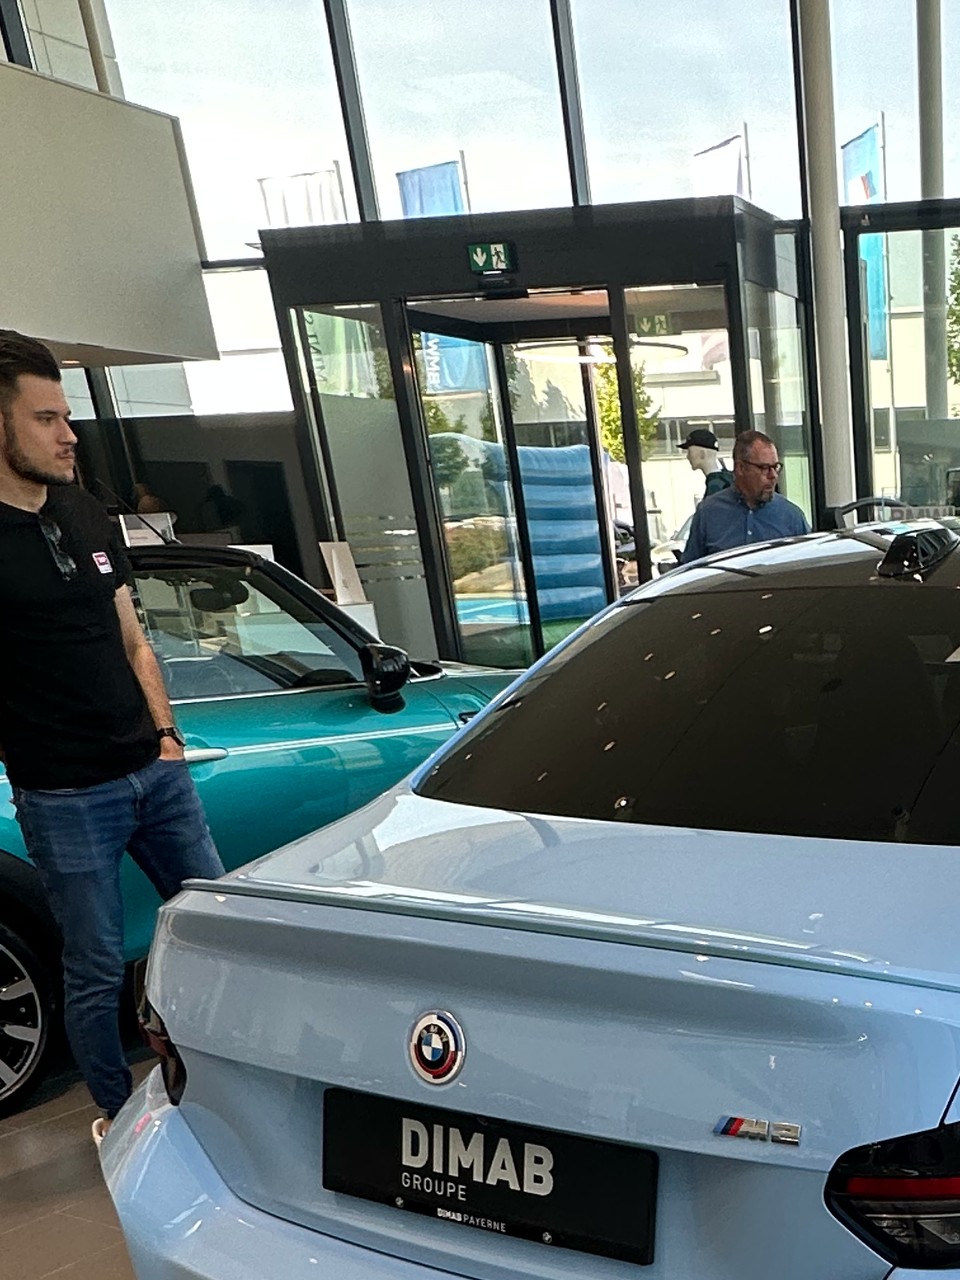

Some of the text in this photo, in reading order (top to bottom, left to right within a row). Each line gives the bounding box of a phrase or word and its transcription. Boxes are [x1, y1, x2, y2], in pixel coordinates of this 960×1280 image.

[402, 1117, 554, 1197] DIMAB
[401, 1172, 467, 1201] GROUPE
[463, 1213, 506, 1233] PAYERNE
